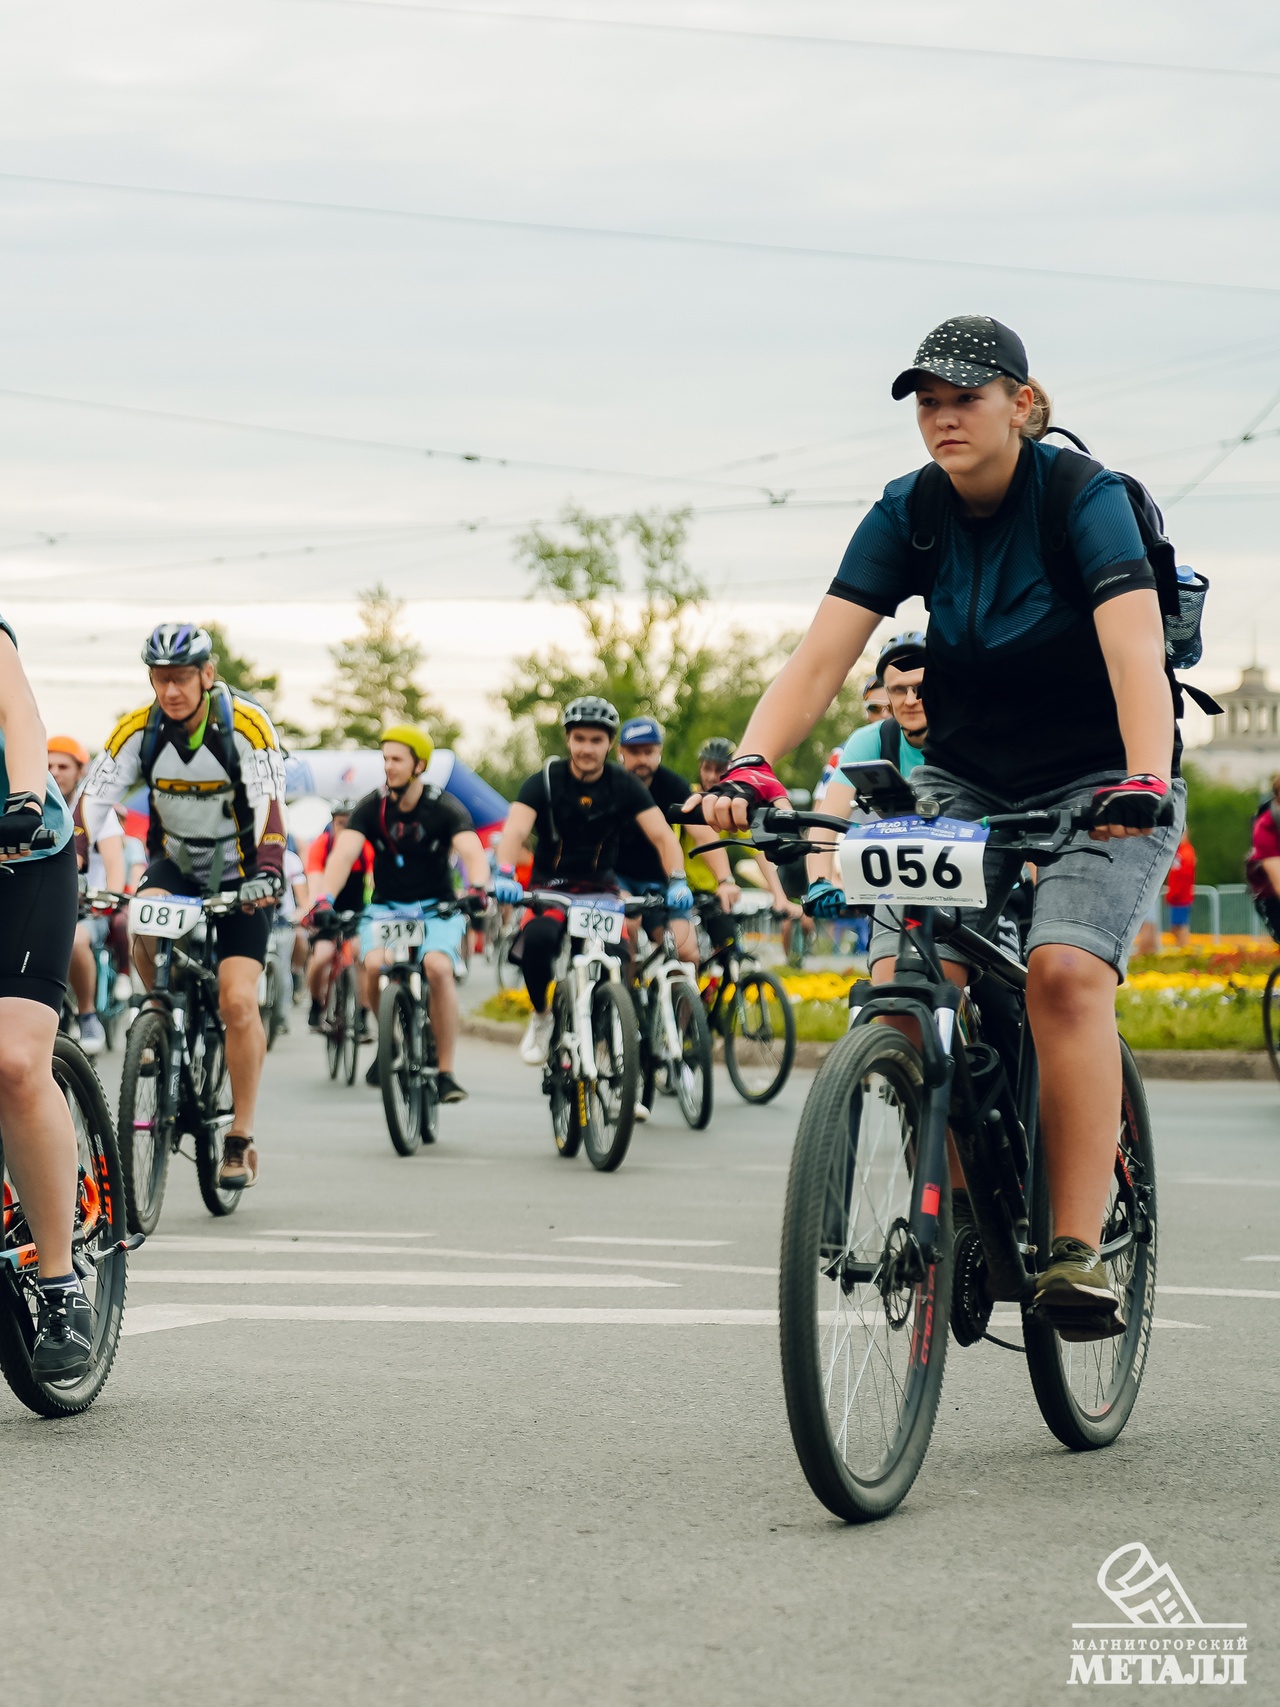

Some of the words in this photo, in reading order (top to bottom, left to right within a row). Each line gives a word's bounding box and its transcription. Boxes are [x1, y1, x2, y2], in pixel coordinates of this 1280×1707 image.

[861, 845, 963, 889] 056
[139, 904, 186, 929] 081
[579, 911, 614, 932] 320
[381, 922, 418, 940] 319
